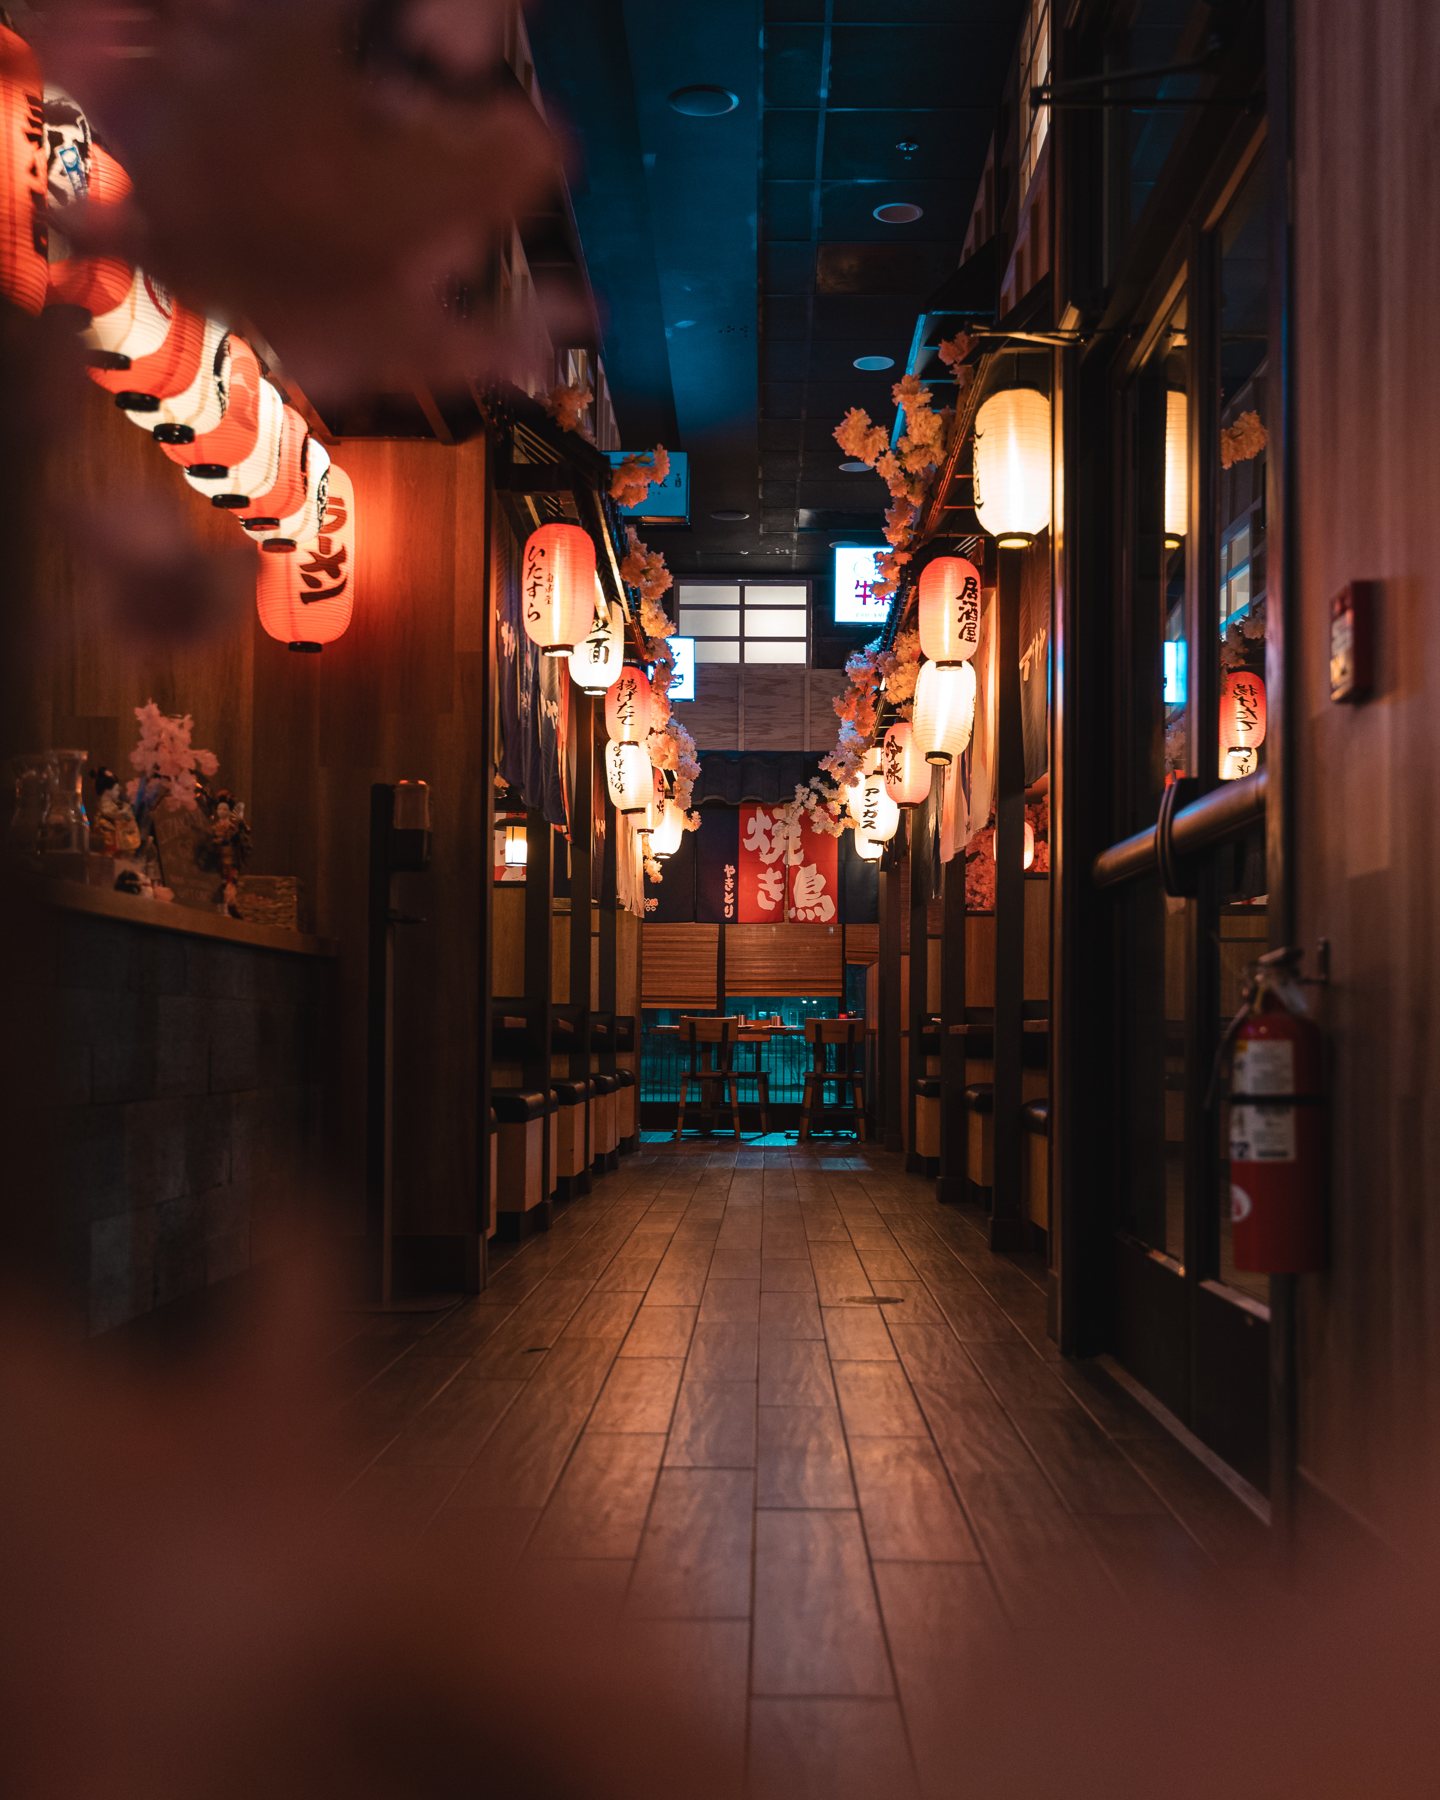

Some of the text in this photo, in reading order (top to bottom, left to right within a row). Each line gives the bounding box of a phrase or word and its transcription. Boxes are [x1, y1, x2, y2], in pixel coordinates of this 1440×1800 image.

[955, 576, 978, 643] 居酒屋
[616, 678, 637, 726] 揚げたて
[861, 787, 880, 830] アンガス
[723, 863, 736, 919] やきとり
